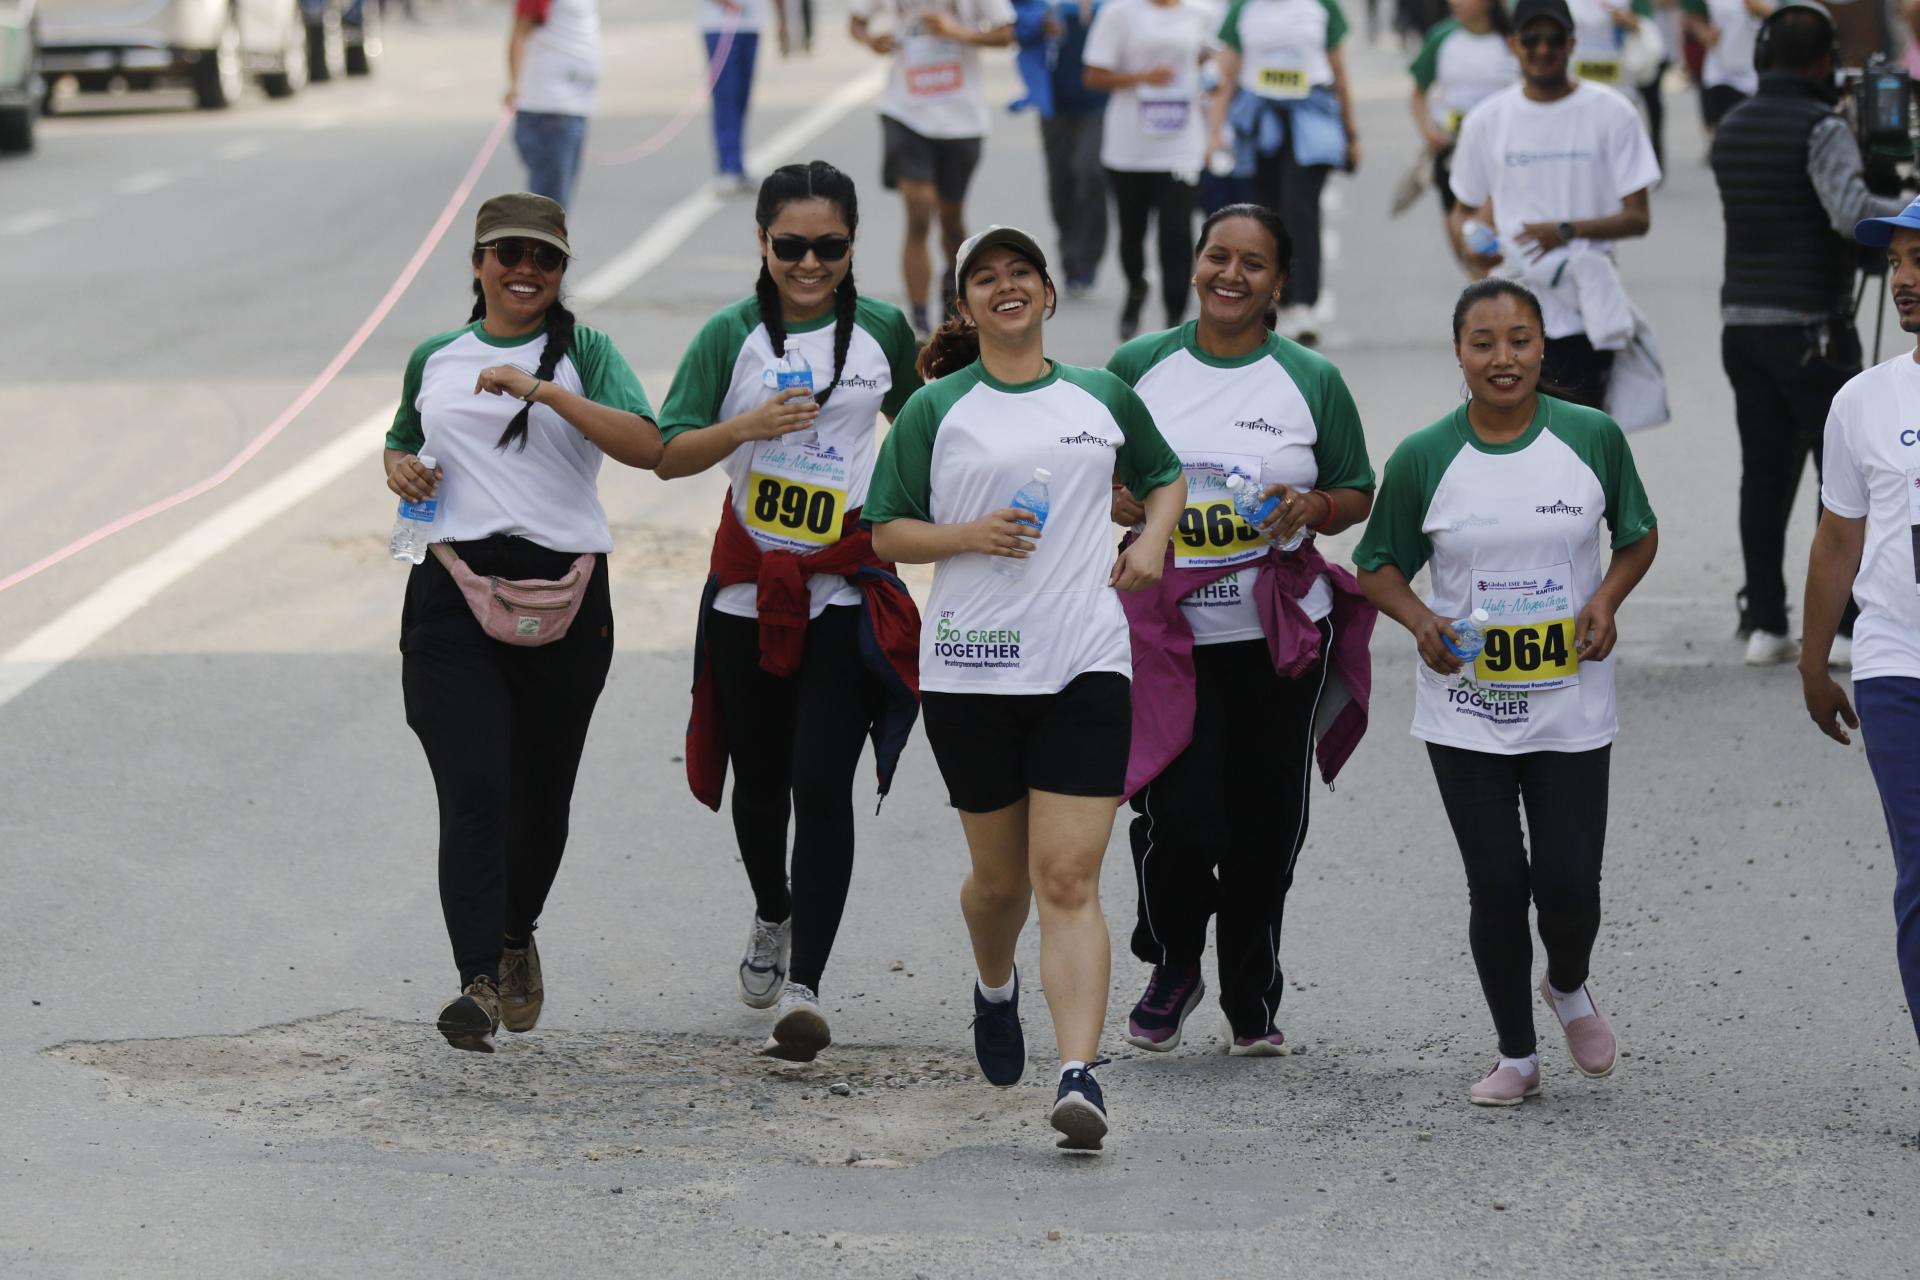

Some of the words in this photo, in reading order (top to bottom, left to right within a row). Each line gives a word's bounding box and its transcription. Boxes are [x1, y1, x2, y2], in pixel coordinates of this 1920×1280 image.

[755, 479, 835, 534] 890
[1536, 499, 1583, 516] कान्तिपुर
[1536, 585, 1563, 595] KANTIPUR
[966, 630, 1020, 643] GREEN
[935, 642, 1020, 658] TOGETHER
[1484, 623, 1568, 672] 964
